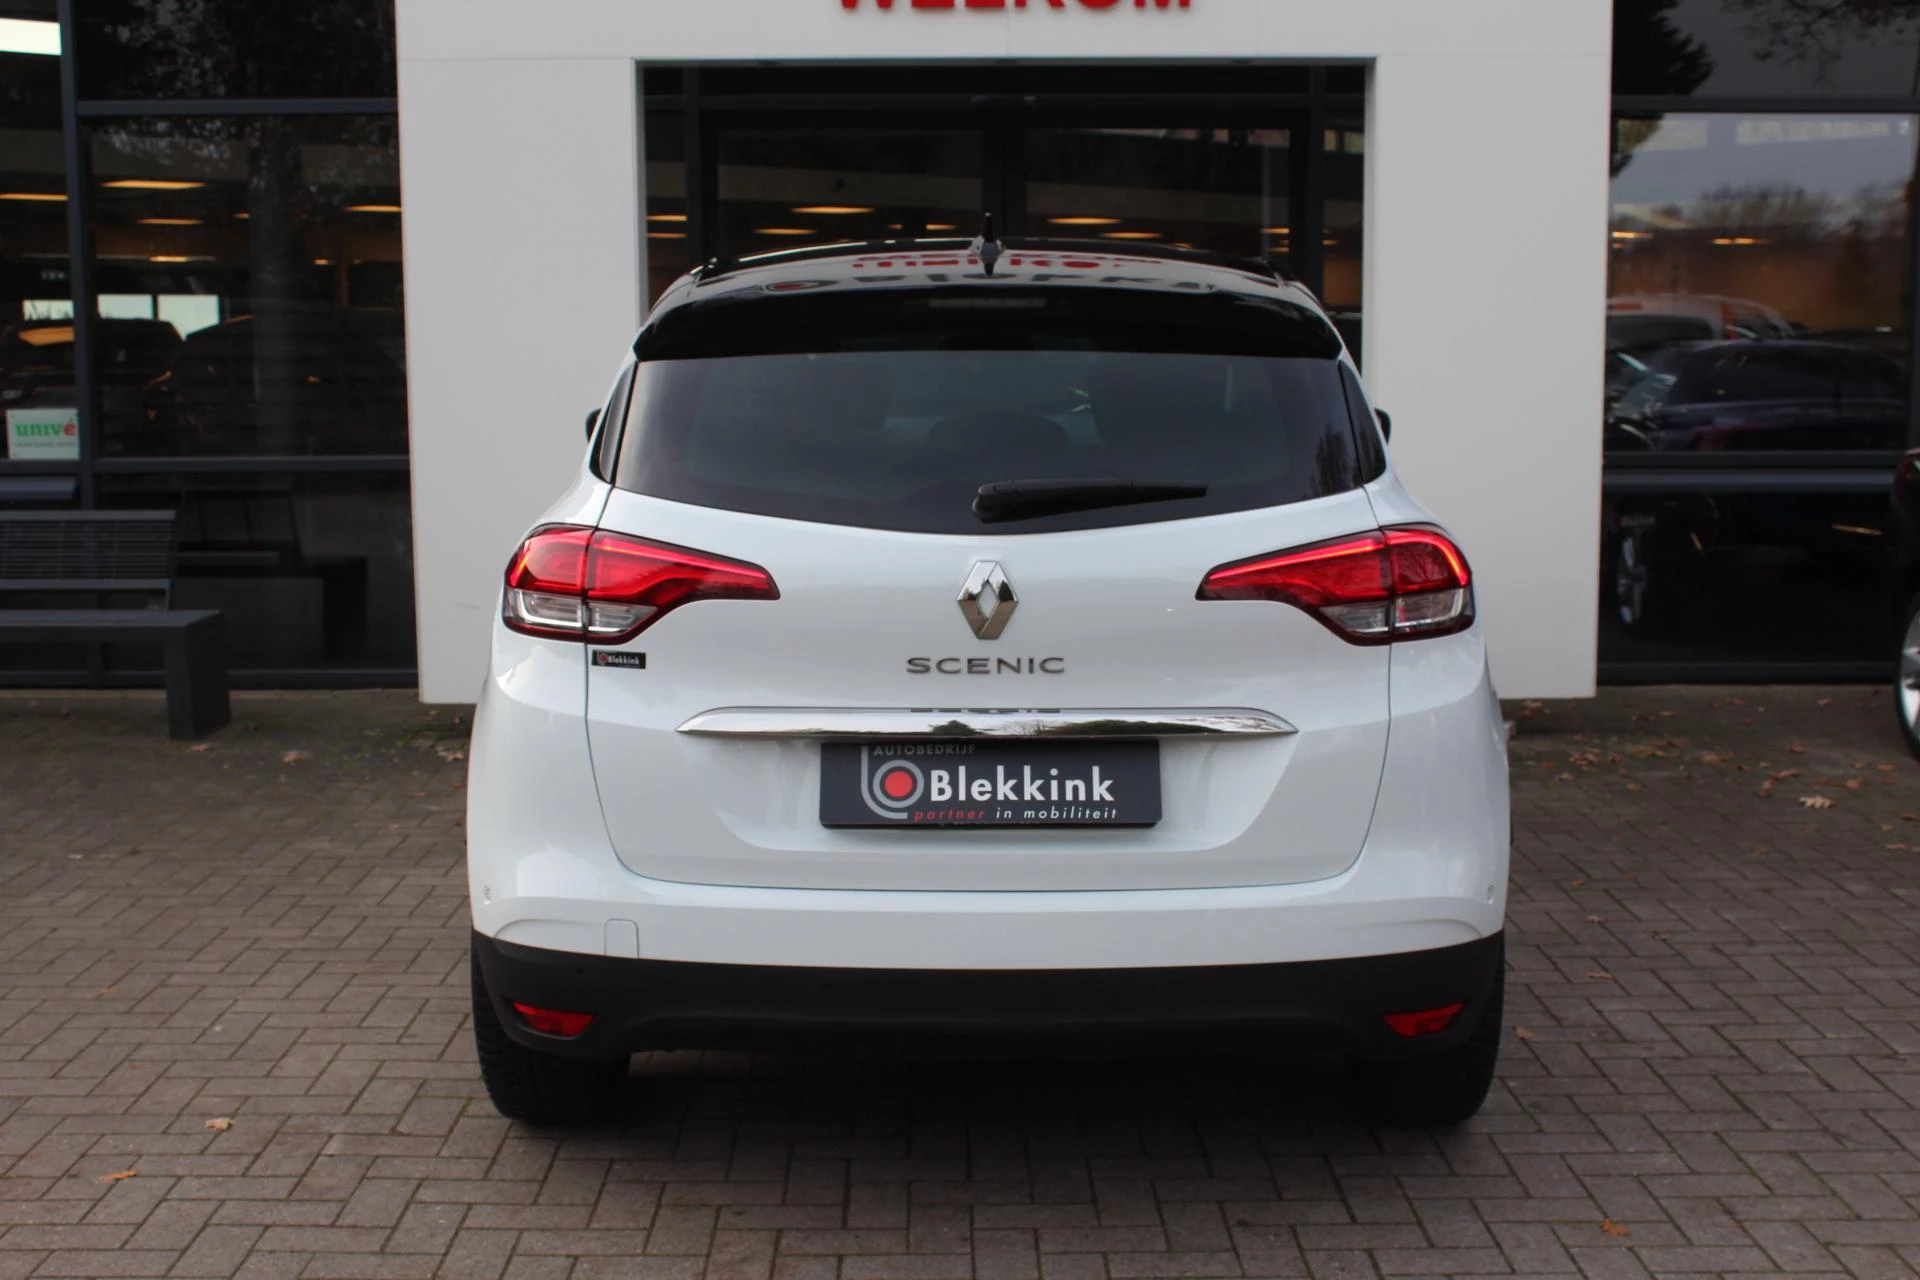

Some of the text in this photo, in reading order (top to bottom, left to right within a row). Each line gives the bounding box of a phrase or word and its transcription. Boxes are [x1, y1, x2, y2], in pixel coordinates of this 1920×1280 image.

[906, 657, 1065, 674] SCENIC
[873, 744, 975, 757] AUTOBEDRIJF
[930, 765, 1114, 801] Blekkink
[914, 806, 1117, 823] partner in mobiliteit
